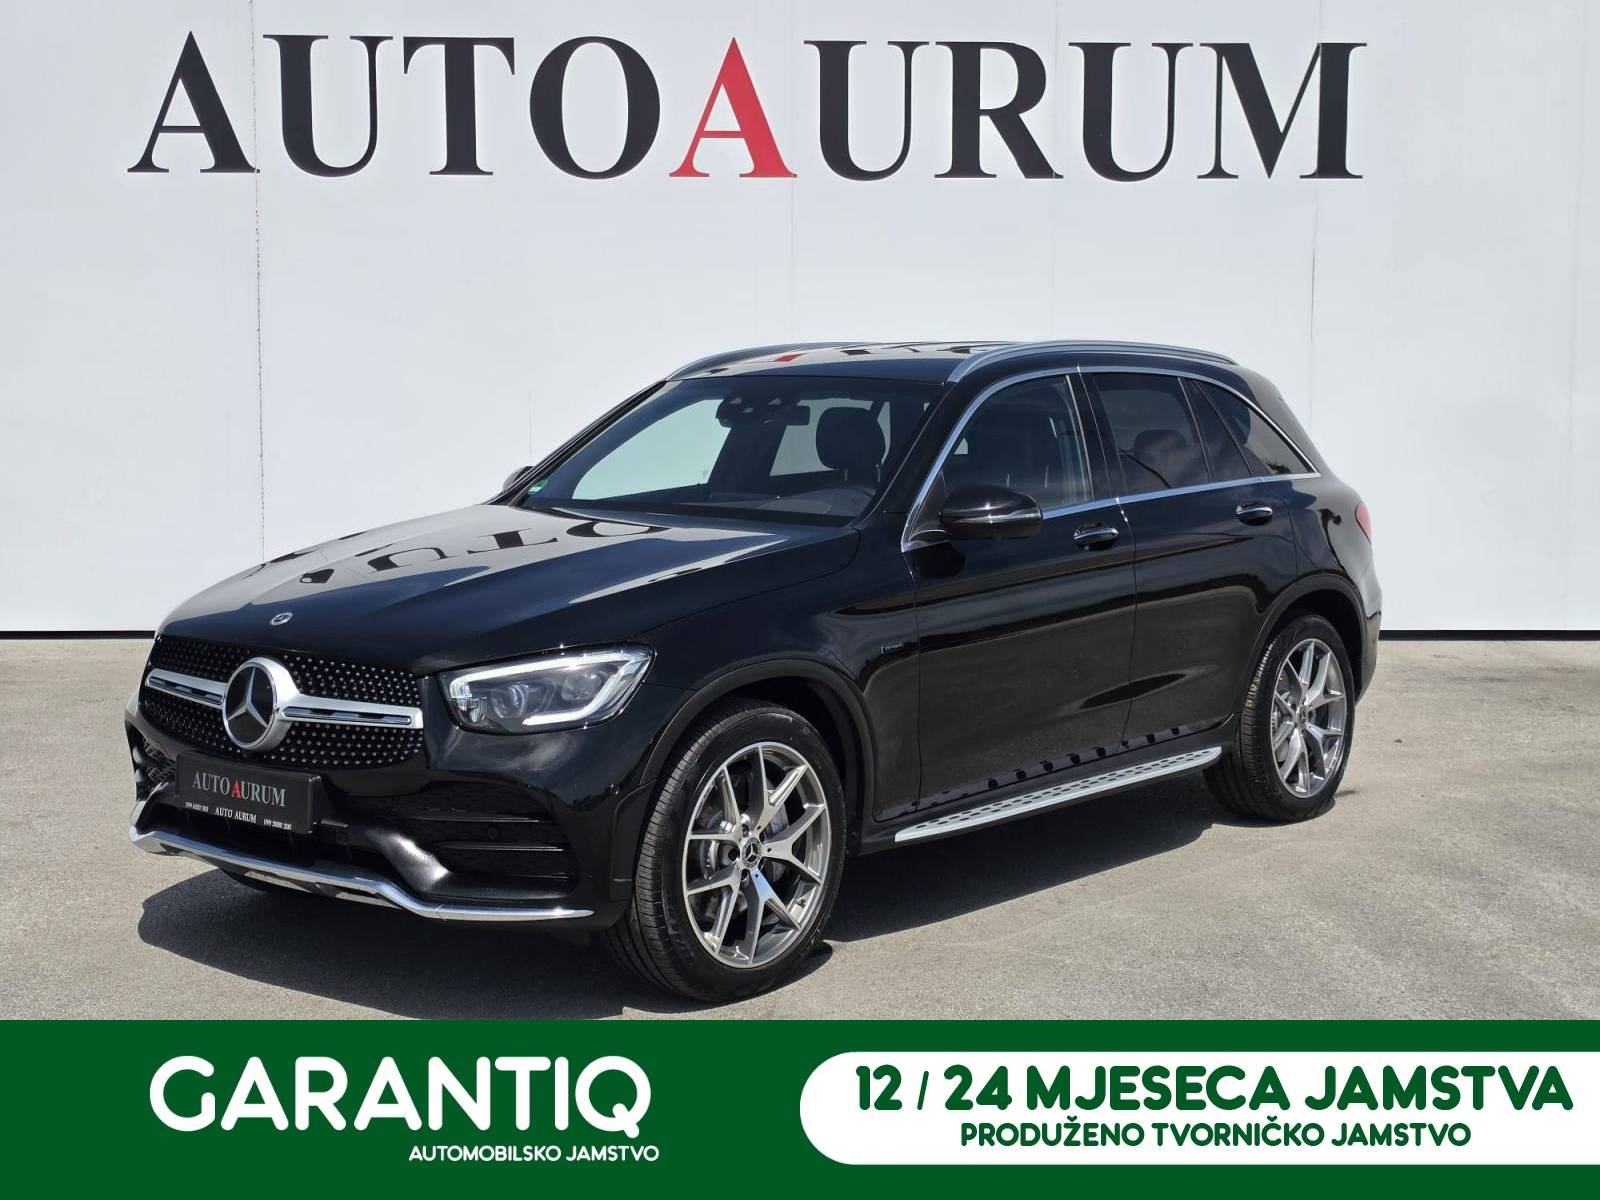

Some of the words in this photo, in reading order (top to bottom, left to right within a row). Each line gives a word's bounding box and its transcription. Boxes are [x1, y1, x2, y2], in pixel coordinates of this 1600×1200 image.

[127, 31, 1367, 182] AUTOAURUM
[215, 807, 233, 818] AUTO
[234, 811, 257, 824] AURUM
